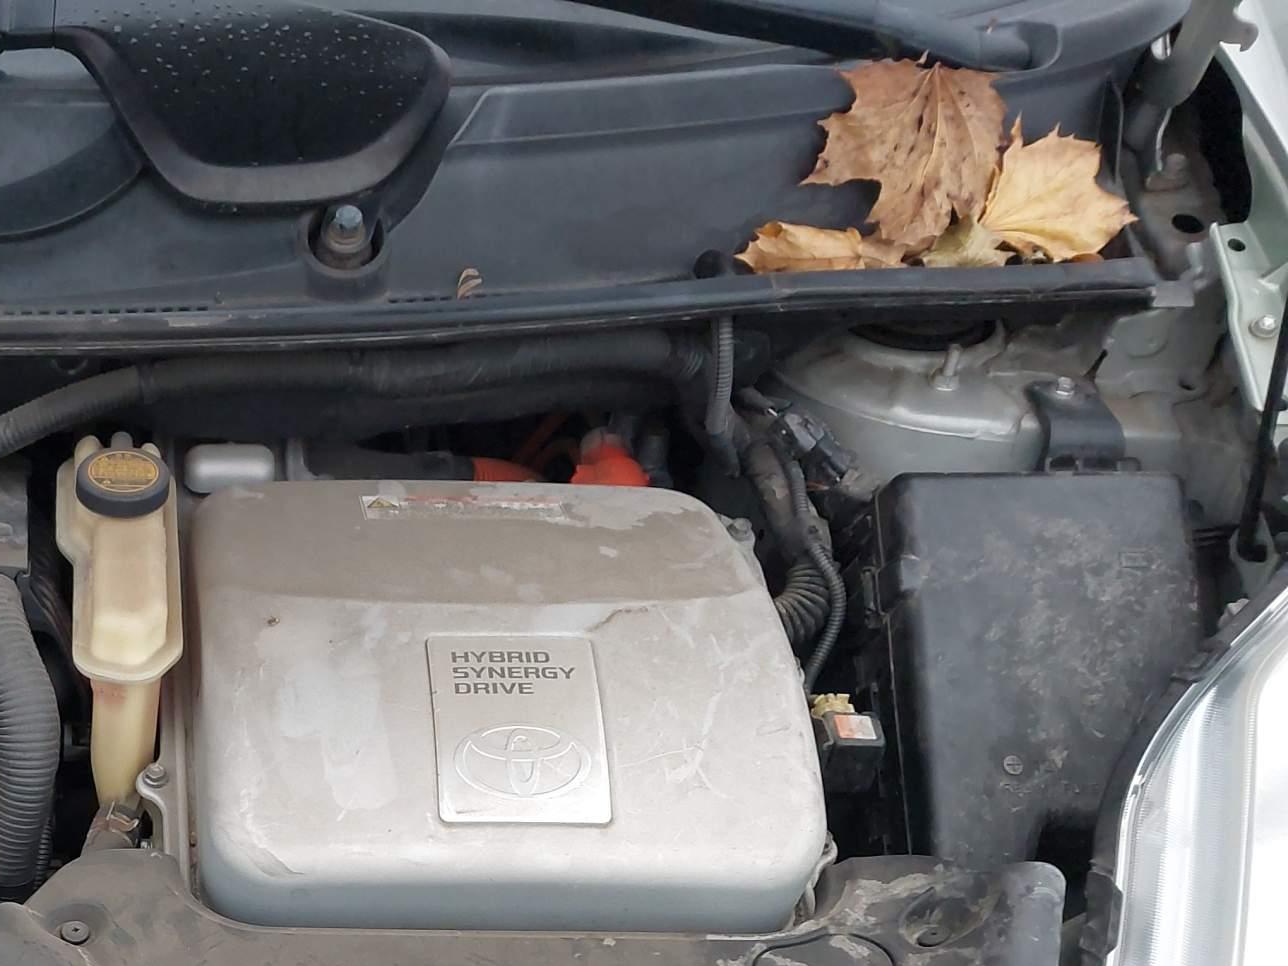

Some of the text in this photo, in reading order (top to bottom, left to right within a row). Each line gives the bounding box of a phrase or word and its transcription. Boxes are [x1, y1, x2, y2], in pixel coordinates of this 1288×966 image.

[451, 651, 551, 664] HYBRID
[452, 666, 576, 680] SYNERGY
[454, 682, 535, 695] DRIVE
